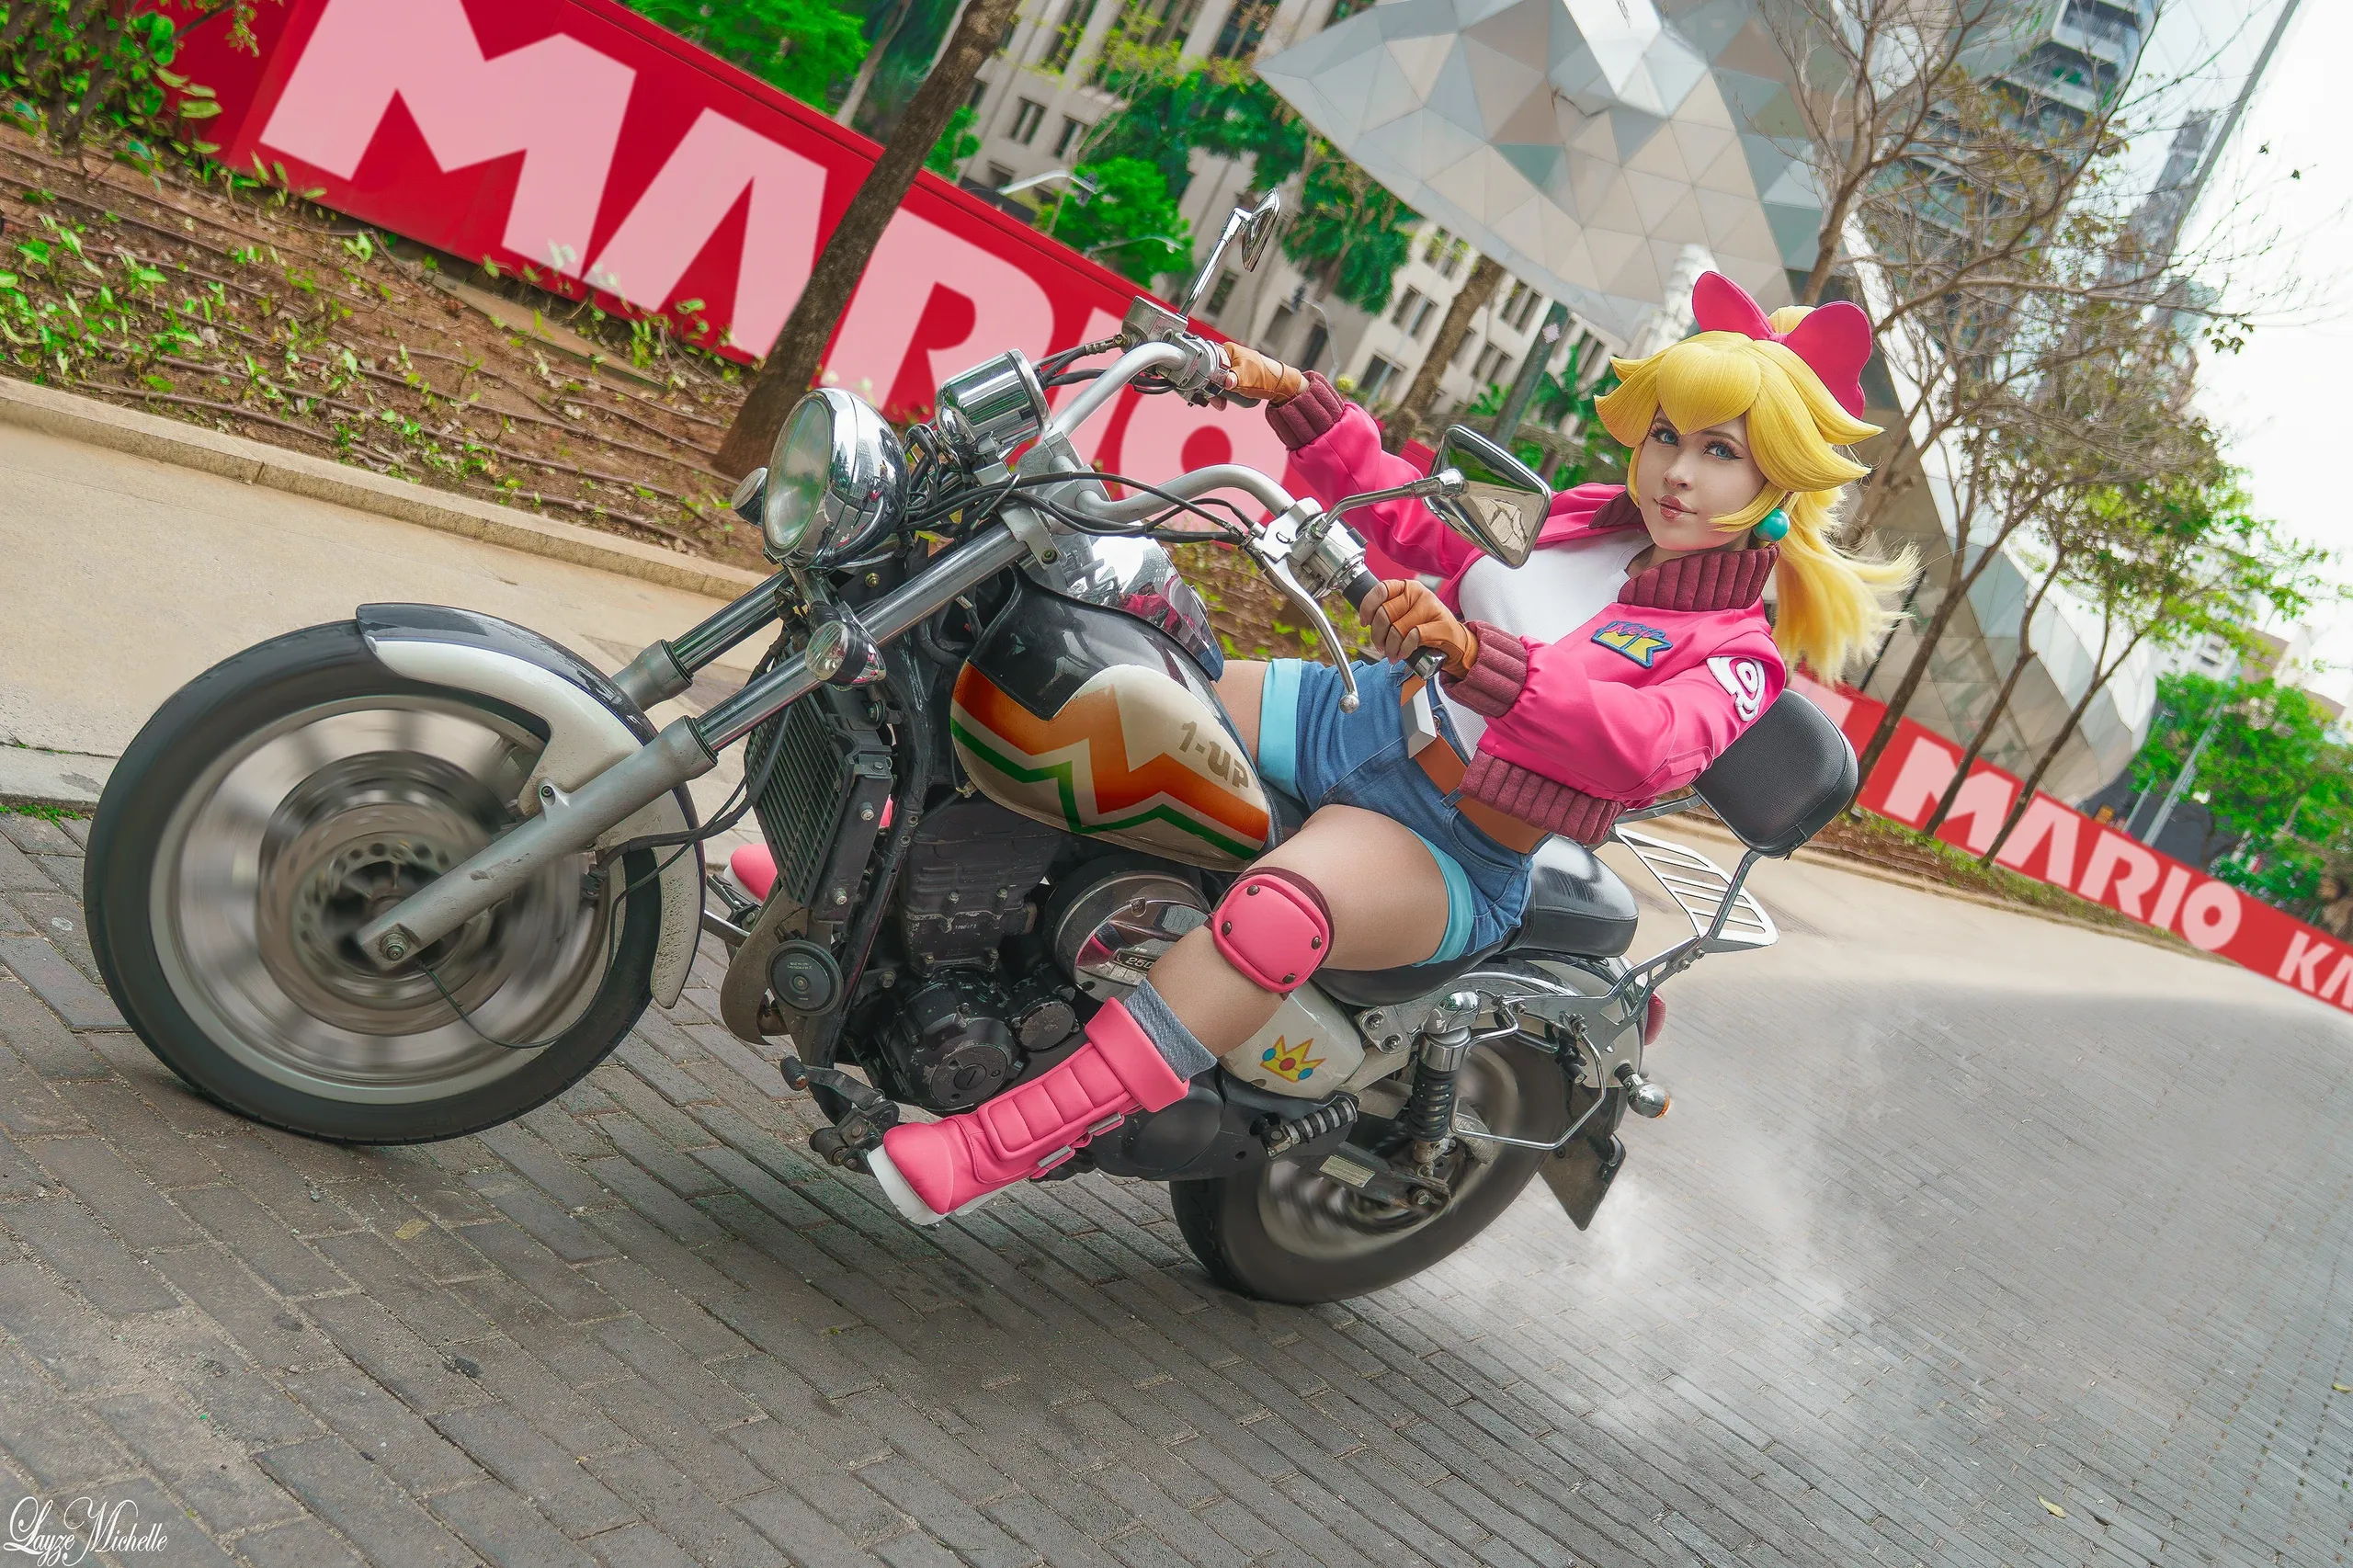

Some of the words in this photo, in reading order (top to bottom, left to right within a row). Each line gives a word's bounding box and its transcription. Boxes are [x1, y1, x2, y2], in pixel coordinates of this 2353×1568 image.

[1179, 721, 1249, 789] 1-UP
[1882, 736, 2242, 952] MARIO
[1126, 957, 1155, 970] 250
